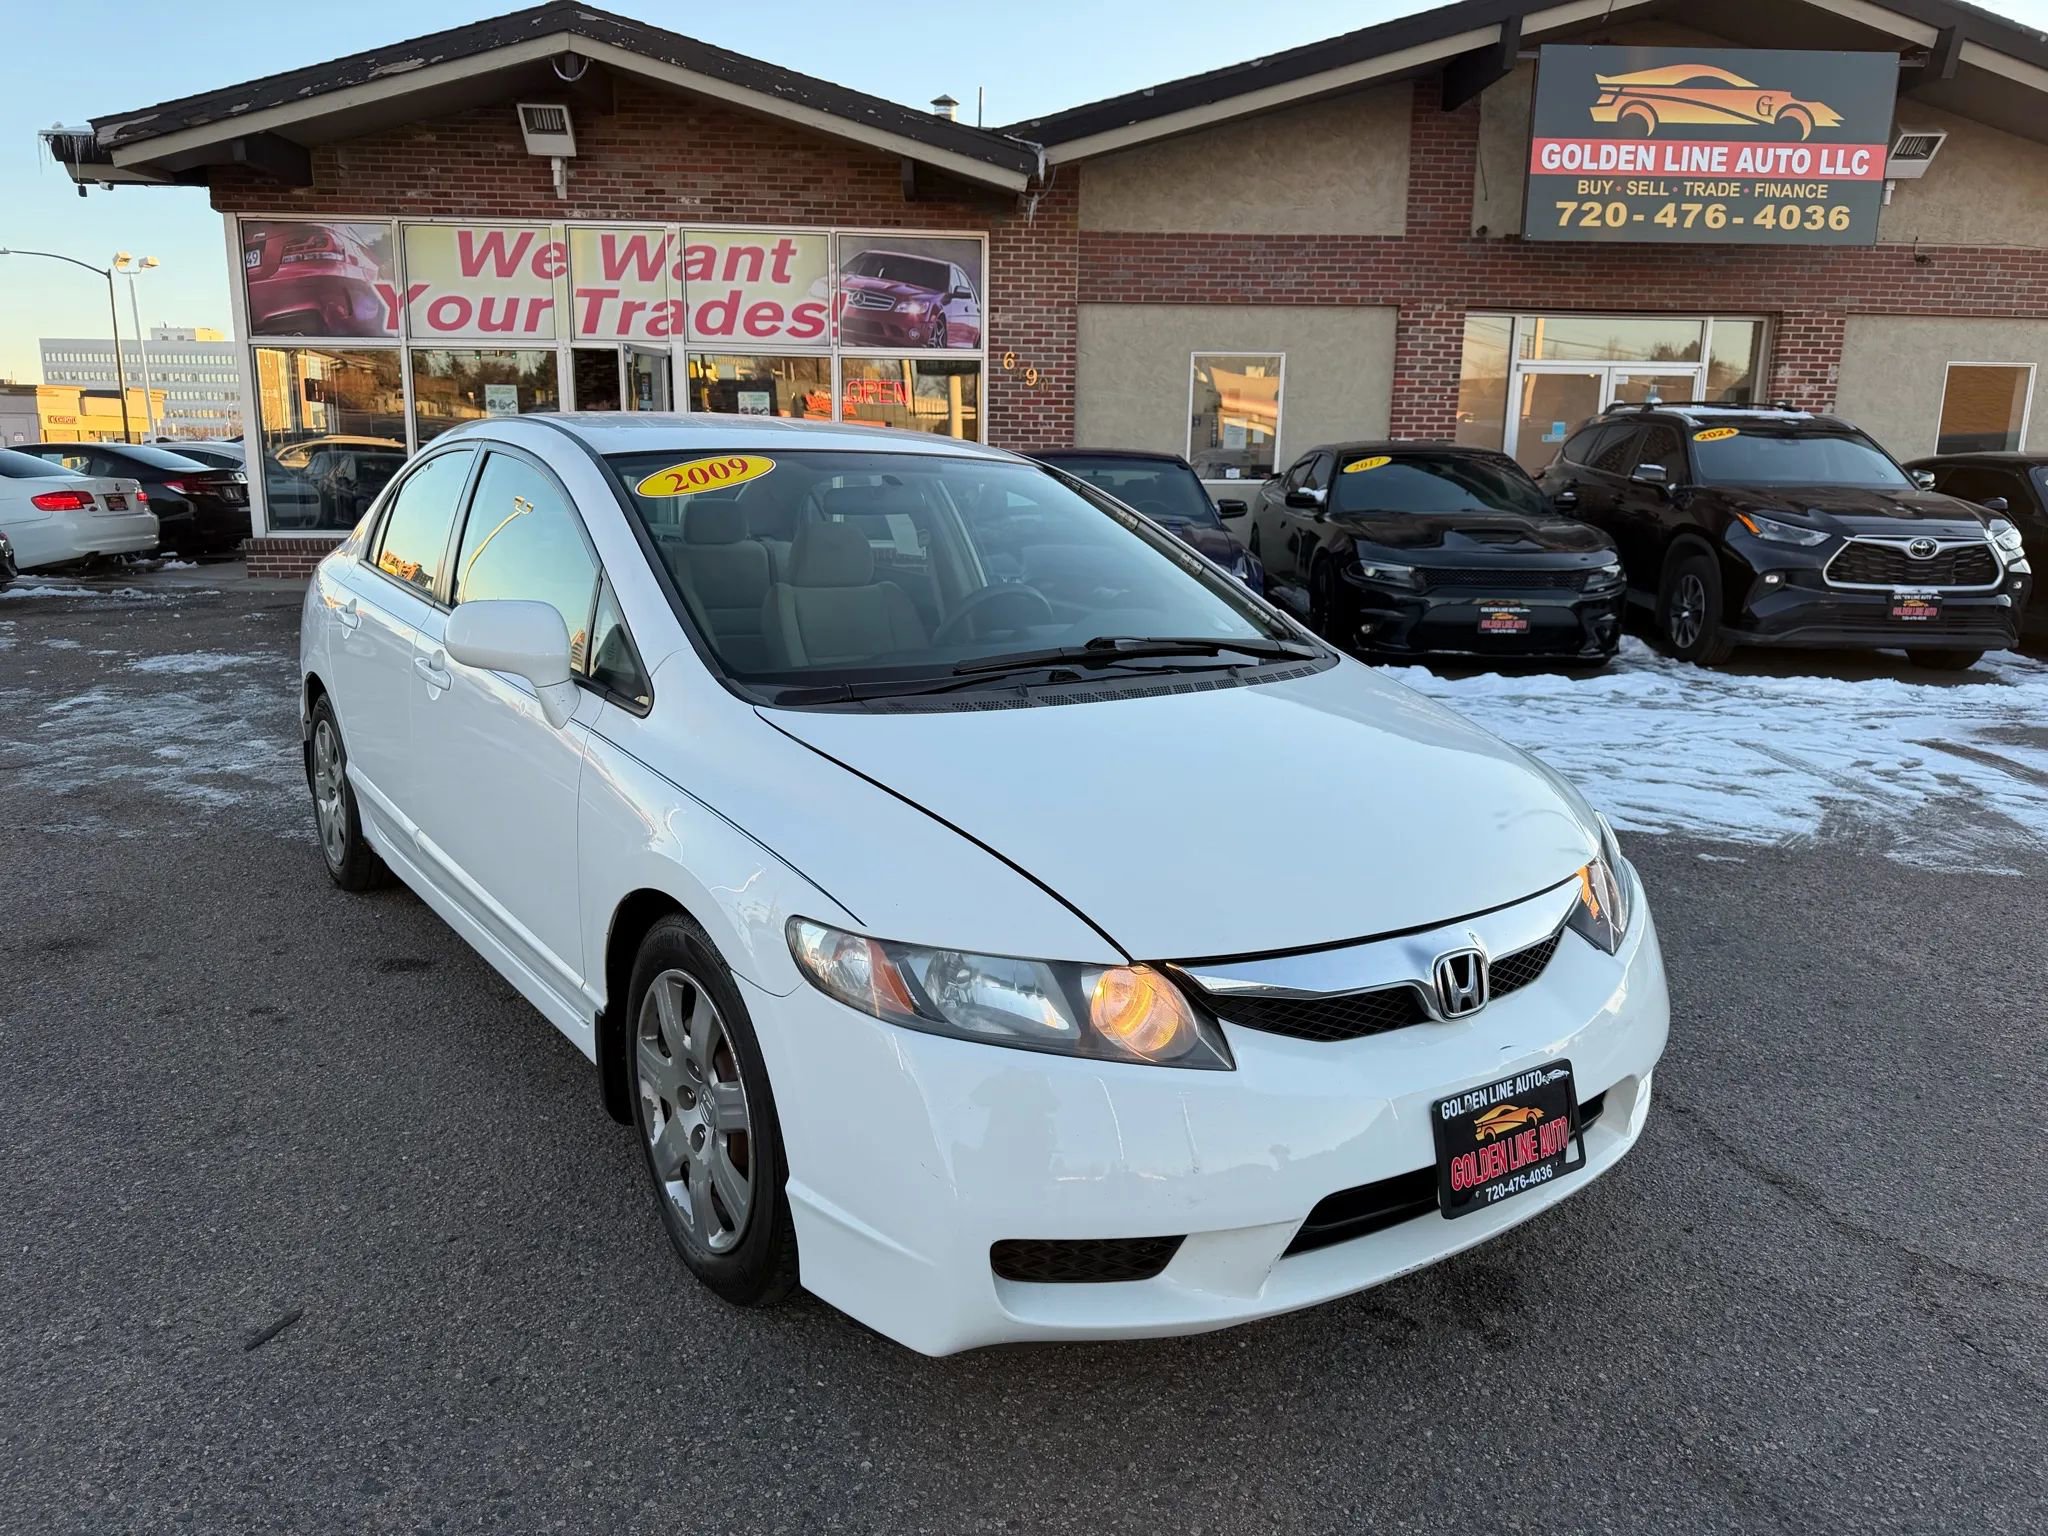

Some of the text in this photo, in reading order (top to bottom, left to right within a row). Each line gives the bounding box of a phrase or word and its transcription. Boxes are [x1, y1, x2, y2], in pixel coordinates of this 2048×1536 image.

[1541, 143, 1870, 175] GOLDEN LINE AUTO LLC
[1577, 180, 1828, 198] BUY SELL TRADE FINANCE
[457, 230, 797, 284] We Want
[374, 284, 847, 339] Your Trades!
[847, 380, 909, 405] OPEN
[1699, 428, 1734, 440] 2024
[665, 457, 748, 492] 2009
[1354, 458, 1382, 471] 2017
[1441, 1069, 1542, 1120] GOLDEN LINE AUTO
[1451, 1116, 1569, 1191] GOLDEN LINE AUTO
[1486, 1164, 1553, 1202] 720-476-4036
